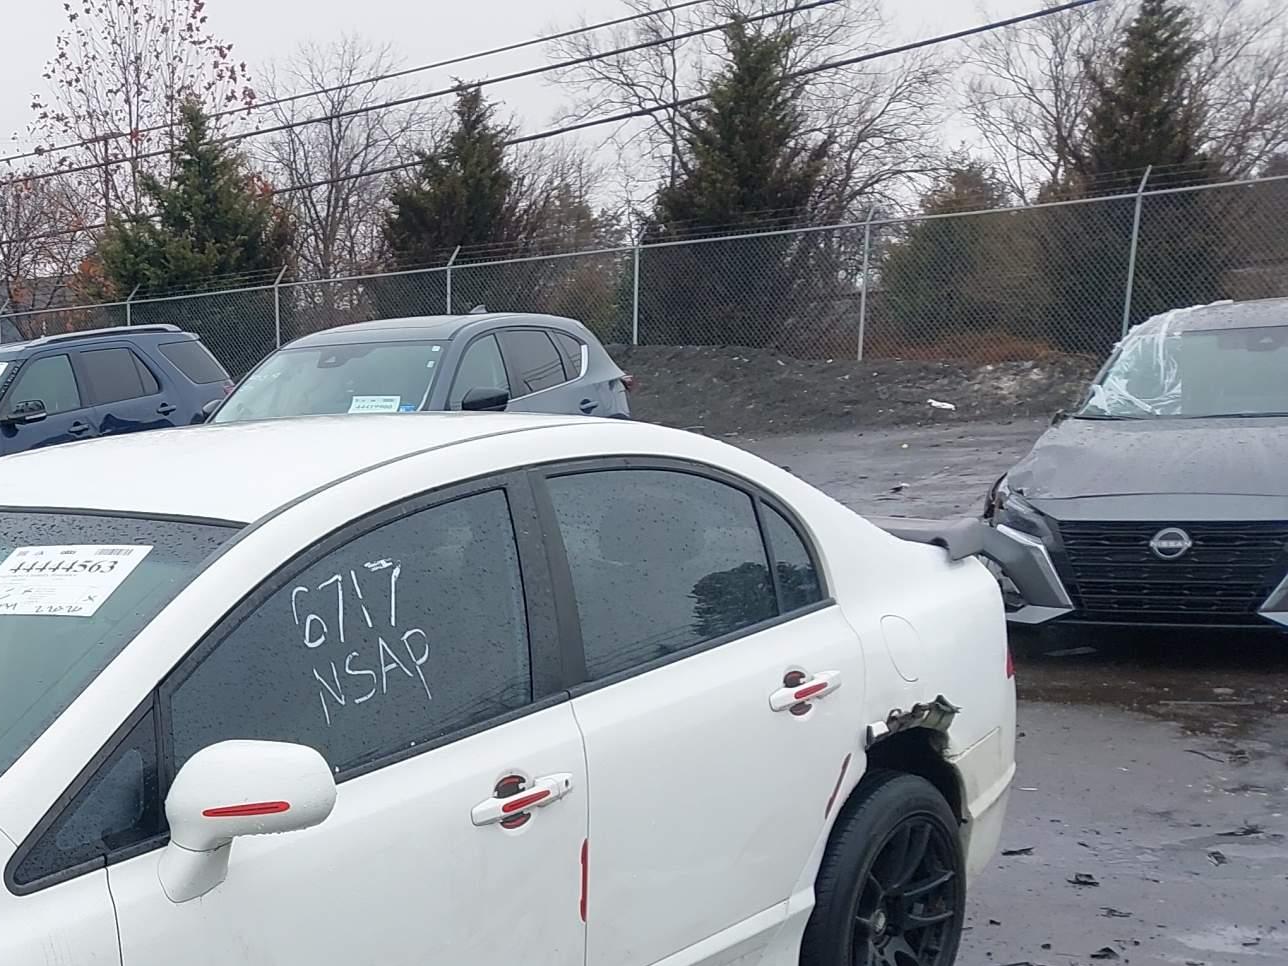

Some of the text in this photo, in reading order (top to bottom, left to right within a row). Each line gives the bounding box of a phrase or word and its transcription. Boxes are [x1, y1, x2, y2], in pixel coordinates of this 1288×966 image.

[10, 560, 118, 574] 44444563
[1149, 540, 1192, 548] NISSAN
[291, 559, 402, 648] 6717
[312, 628, 433, 727] NSAP
